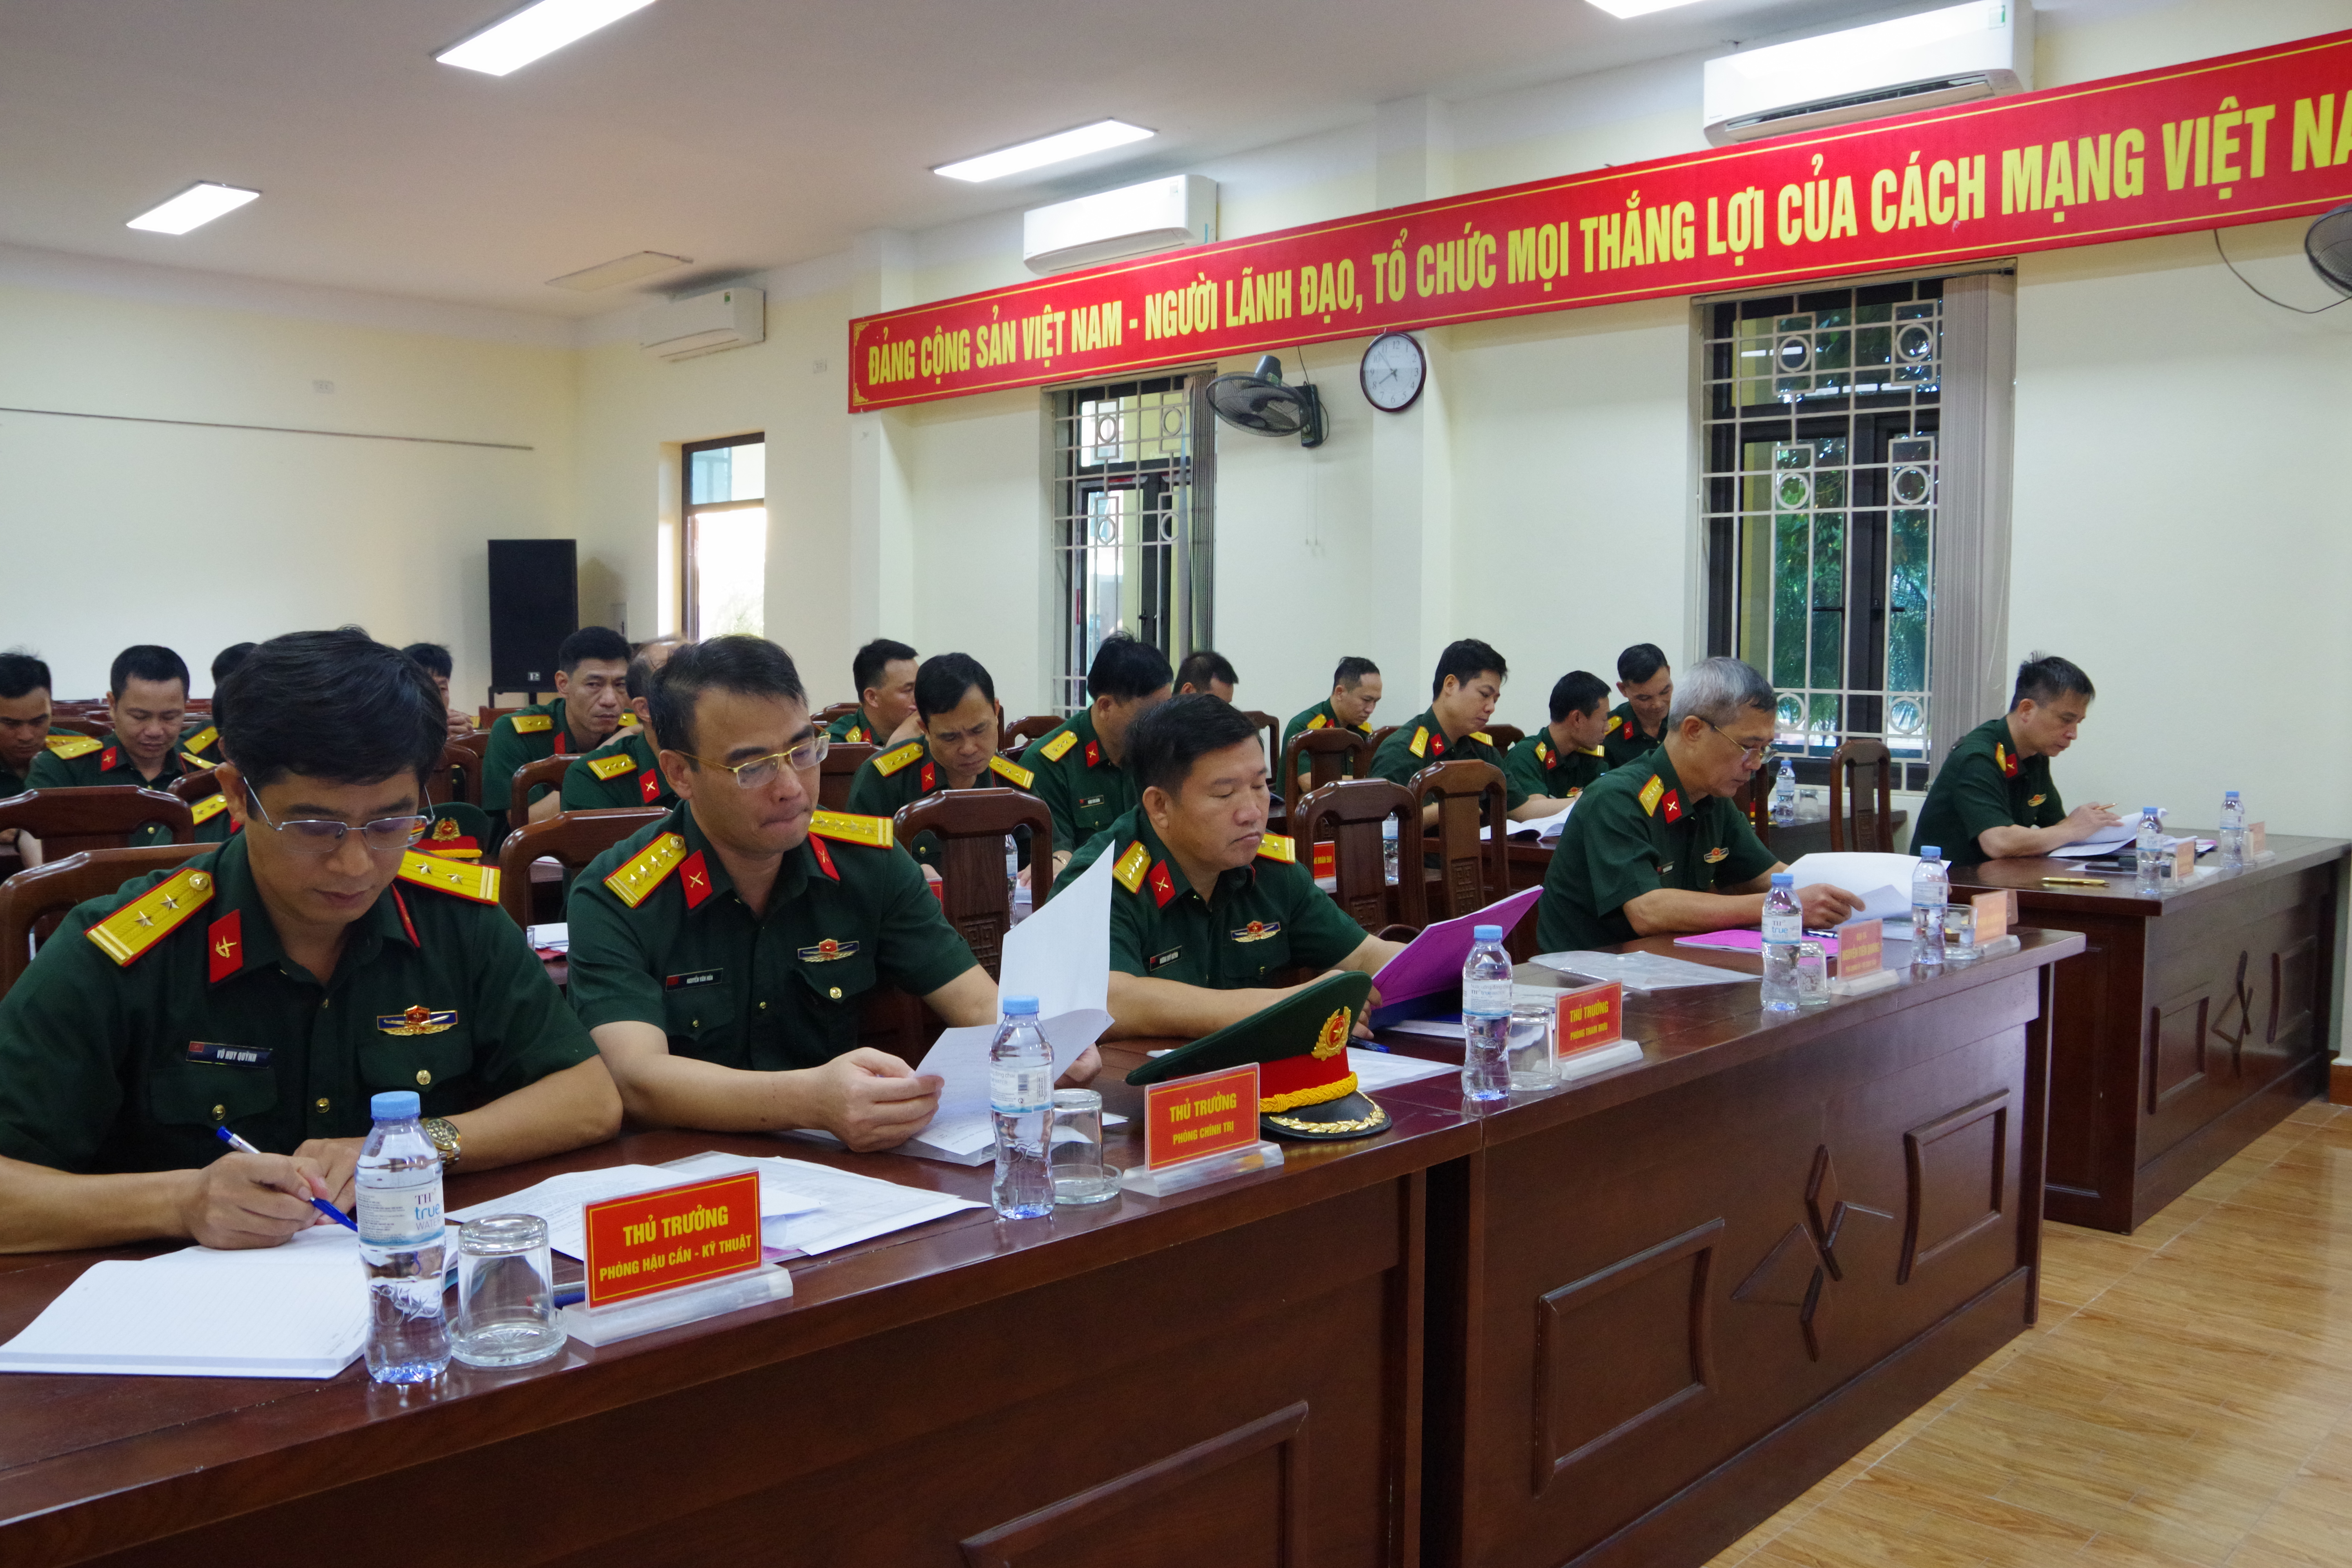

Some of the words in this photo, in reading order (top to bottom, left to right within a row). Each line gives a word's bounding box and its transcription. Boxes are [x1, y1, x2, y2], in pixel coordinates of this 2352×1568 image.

[868, 327, 915, 385] ĐẢNG
[920, 325, 970, 384] CỘNG
[976, 304, 1016, 368] SẢN
[1022, 303, 1066, 368] VIỆT
[1071, 300, 1122, 354] NAM
[1145, 271, 1218, 341] NGƯỜI
[1225, 267, 1292, 328] LÃNH
[1299, 258, 1363, 324] ĐẠO,
[1372, 228, 1406, 304] TỔ
[1416, 222, 1497, 298] CHỨC
[1507, 221, 1569, 292] MỌI
[1579, 189, 1695, 273] THẮNG
[1707, 185, 1764, 267] LỢI
[1777, 153, 1858, 246] CỦA
[1871, 151, 1986, 233] CÁCH
[2001, 128, 2145, 223] MẠNG
[2161, 96, 2276, 200] VIỆT
[1392, 340, 1400, 349] 12
[1373, 354, 1380, 363] 10
[1412, 354, 1416, 362] 2
[1414, 368, 1419, 376] 3
[1372, 381, 1376, 390] 8
[1402, 391, 1406, 400] 5
[1570, 1004, 1582, 1023] THỦ
[1584, 999, 1609, 1019] TRƯỞNG
[225, 1050, 237, 1060] HUY
[1169, 1098, 1191, 1123] THỦ
[1194, 1091, 1237, 1117] TRƯỞNG
[1172, 1129, 1198, 1145] PHÒNG
[1200, 1123, 1221, 1138] CHÍNH
[1223, 1120, 1234, 1132] TRỊ
[414, 1192, 431, 1205] TH
[415, 1203, 440, 1220] true
[416, 1216, 441, 1230] WATER
[622, 1214, 656, 1247] THỦ
[661, 1204, 729, 1238] TRƯỞNG
[599, 1260, 640, 1282] PHÒNG
[642, 1253, 666, 1273] HẬU
[668, 1245, 692, 1266] CẦN
[702, 1241, 716, 1258] KỸ
[719, 1233, 752, 1254] THUẬT
